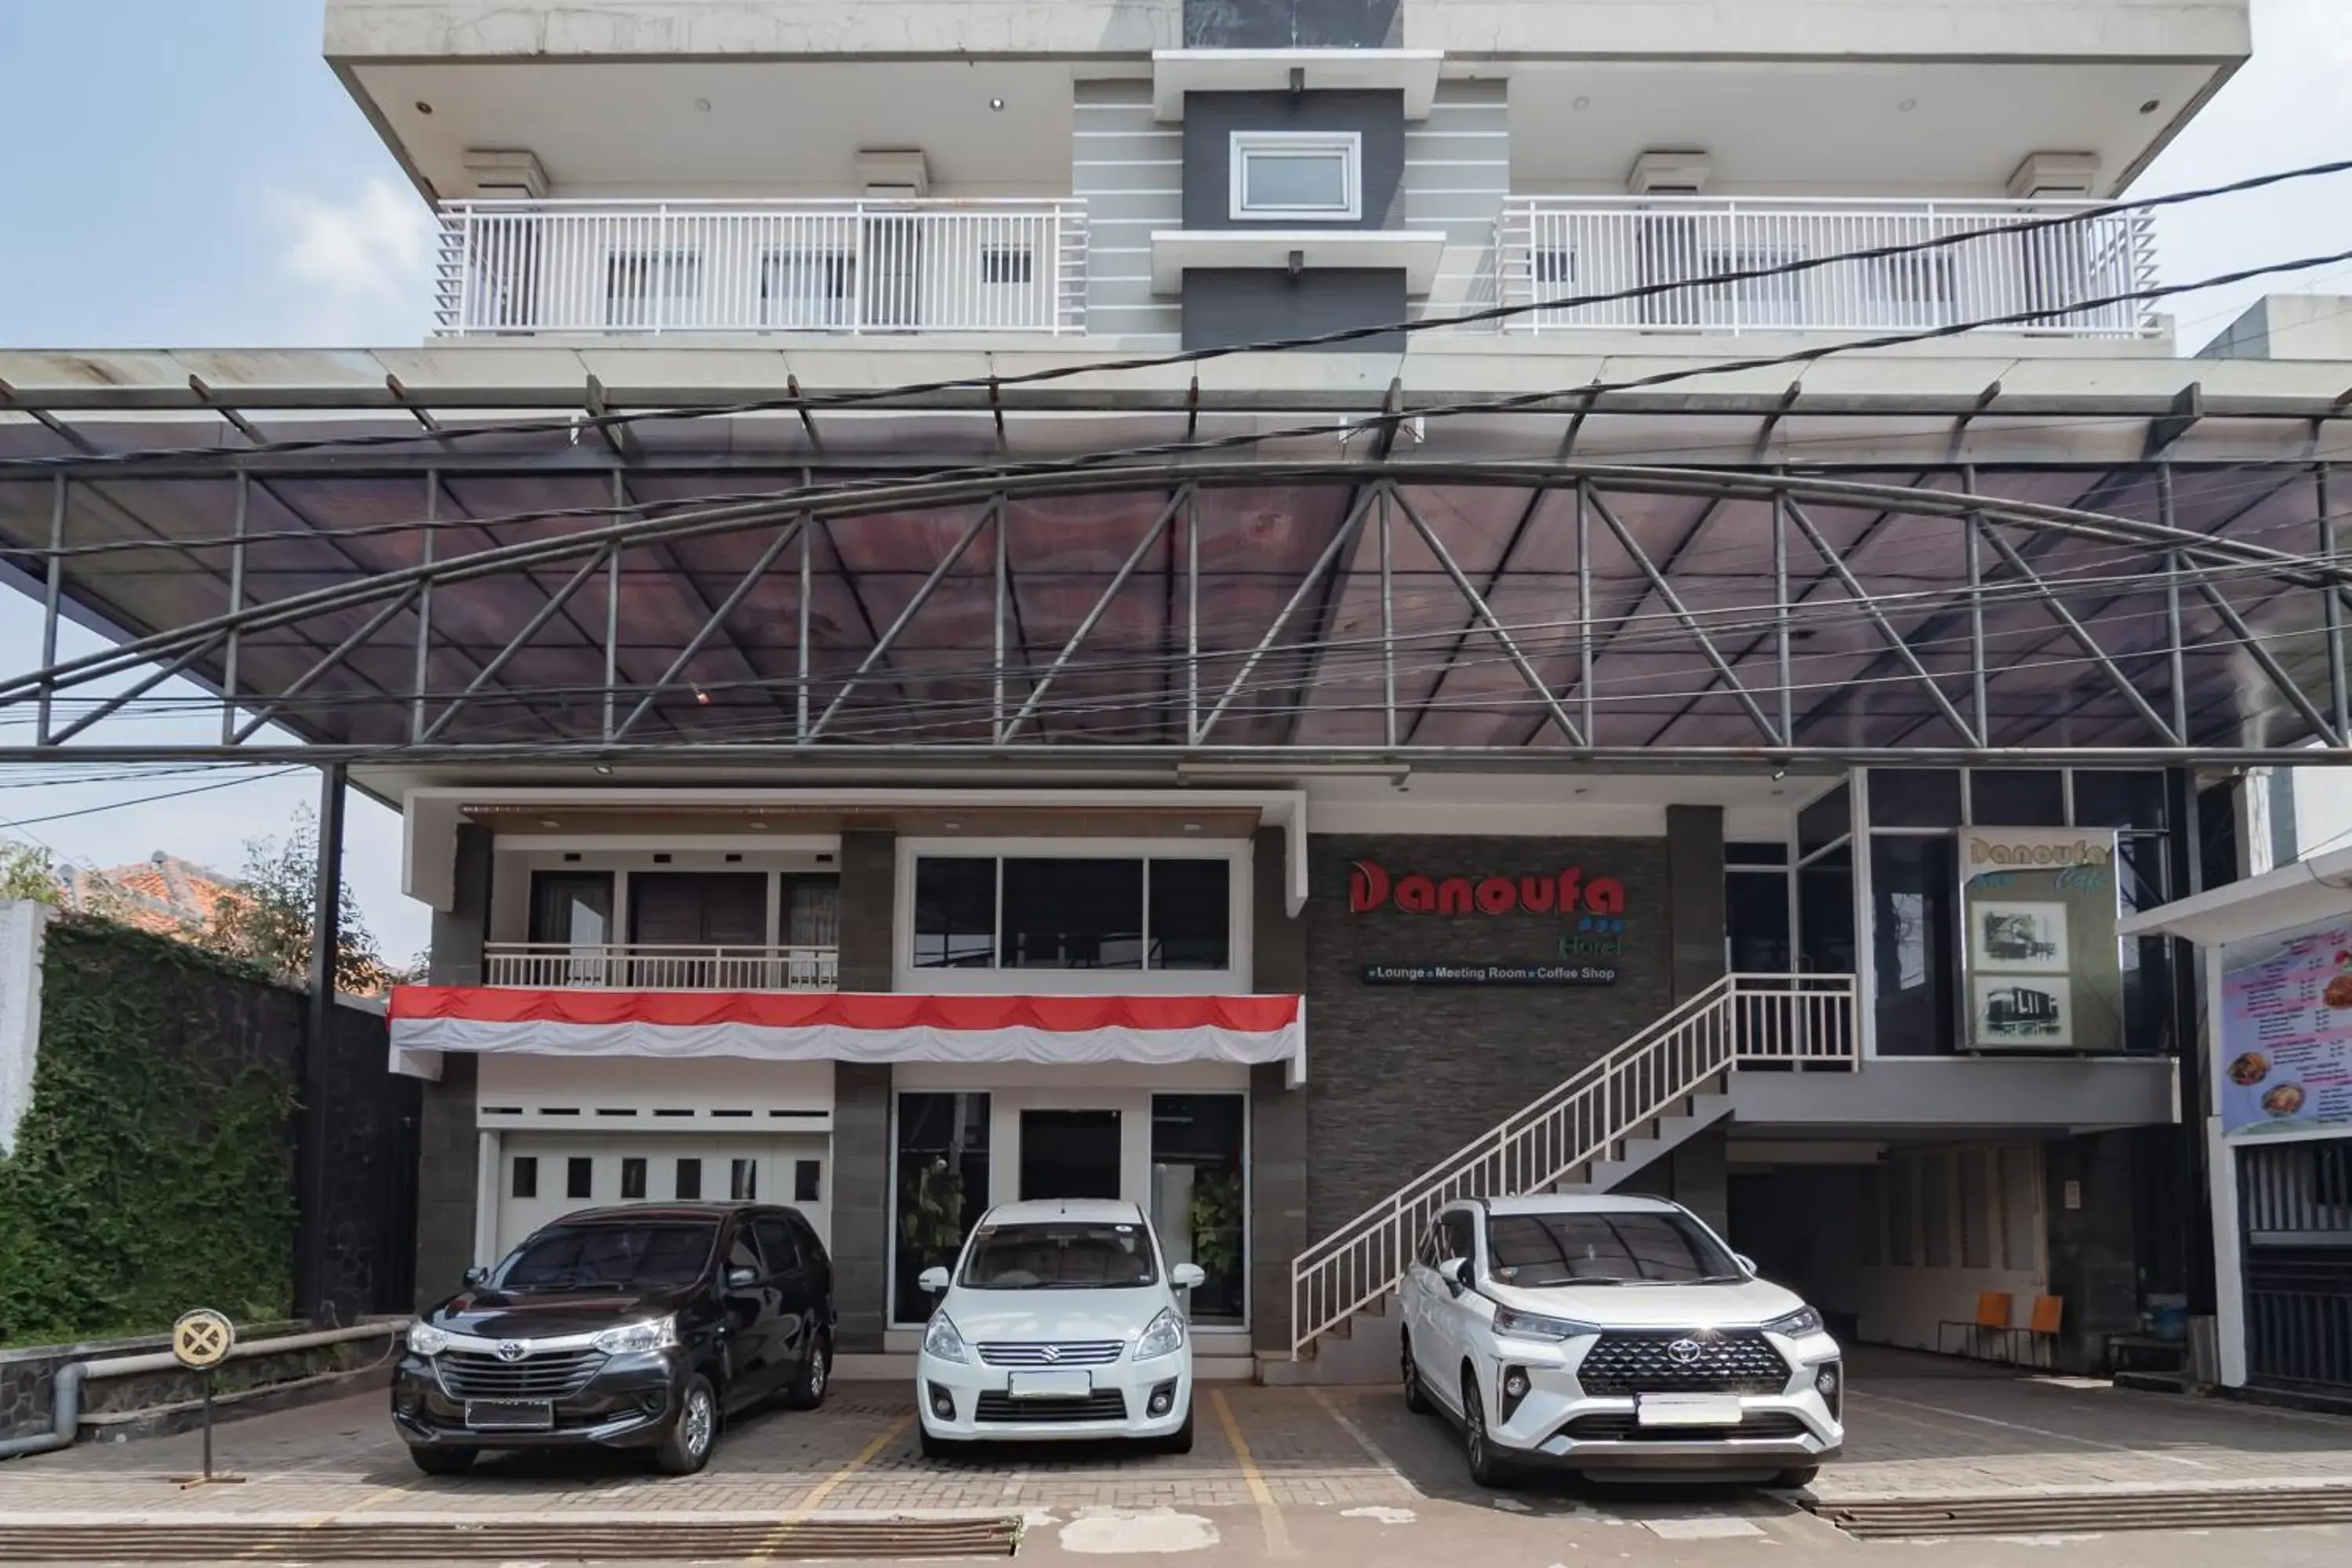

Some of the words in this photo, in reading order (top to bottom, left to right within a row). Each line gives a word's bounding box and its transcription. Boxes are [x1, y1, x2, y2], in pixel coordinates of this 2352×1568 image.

[1348, 860, 1626, 916] Danoufa
[1377, 966, 1425, 981] Lounge
[1436, 966, 1486, 981] Meeting
[1489, 967, 1526, 978] Room
[1537, 967, 1578, 978] Coffee
[1581, 967, 1615, 981] Shop
